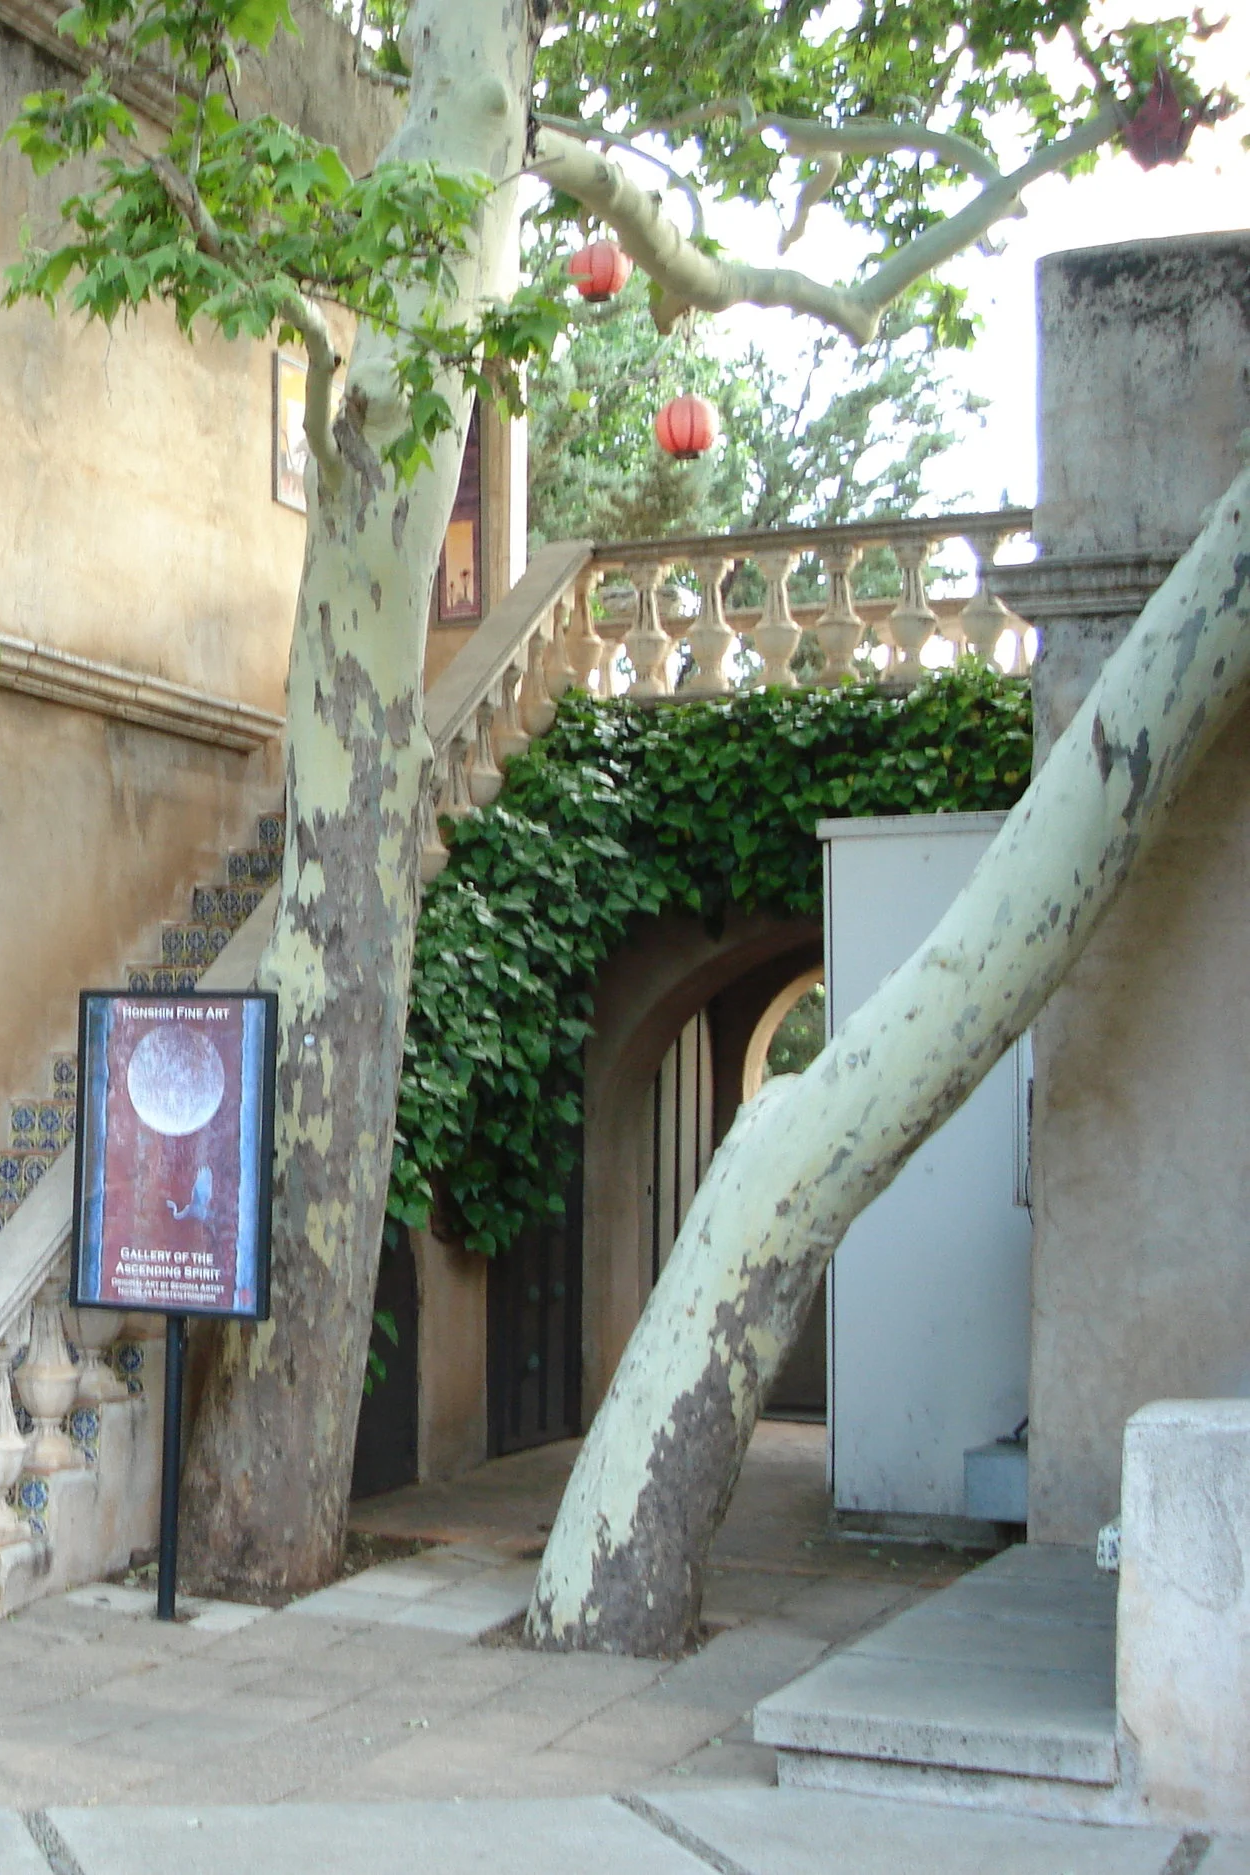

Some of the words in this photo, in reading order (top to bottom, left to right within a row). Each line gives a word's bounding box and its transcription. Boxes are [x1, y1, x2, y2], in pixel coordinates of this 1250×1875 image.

[122, 1005, 174, 1020] HONSHIN
[176, 1006, 203, 1021] FINE
[206, 1006, 230, 1021] ART
[120, 1246, 171, 1263] GALLERY
[173, 1250, 190, 1264] OF
[190, 1251, 214, 1266] THE
[115, 1260, 182, 1279] ASCENDING
[183, 1265, 221, 1281] SPIRIT
